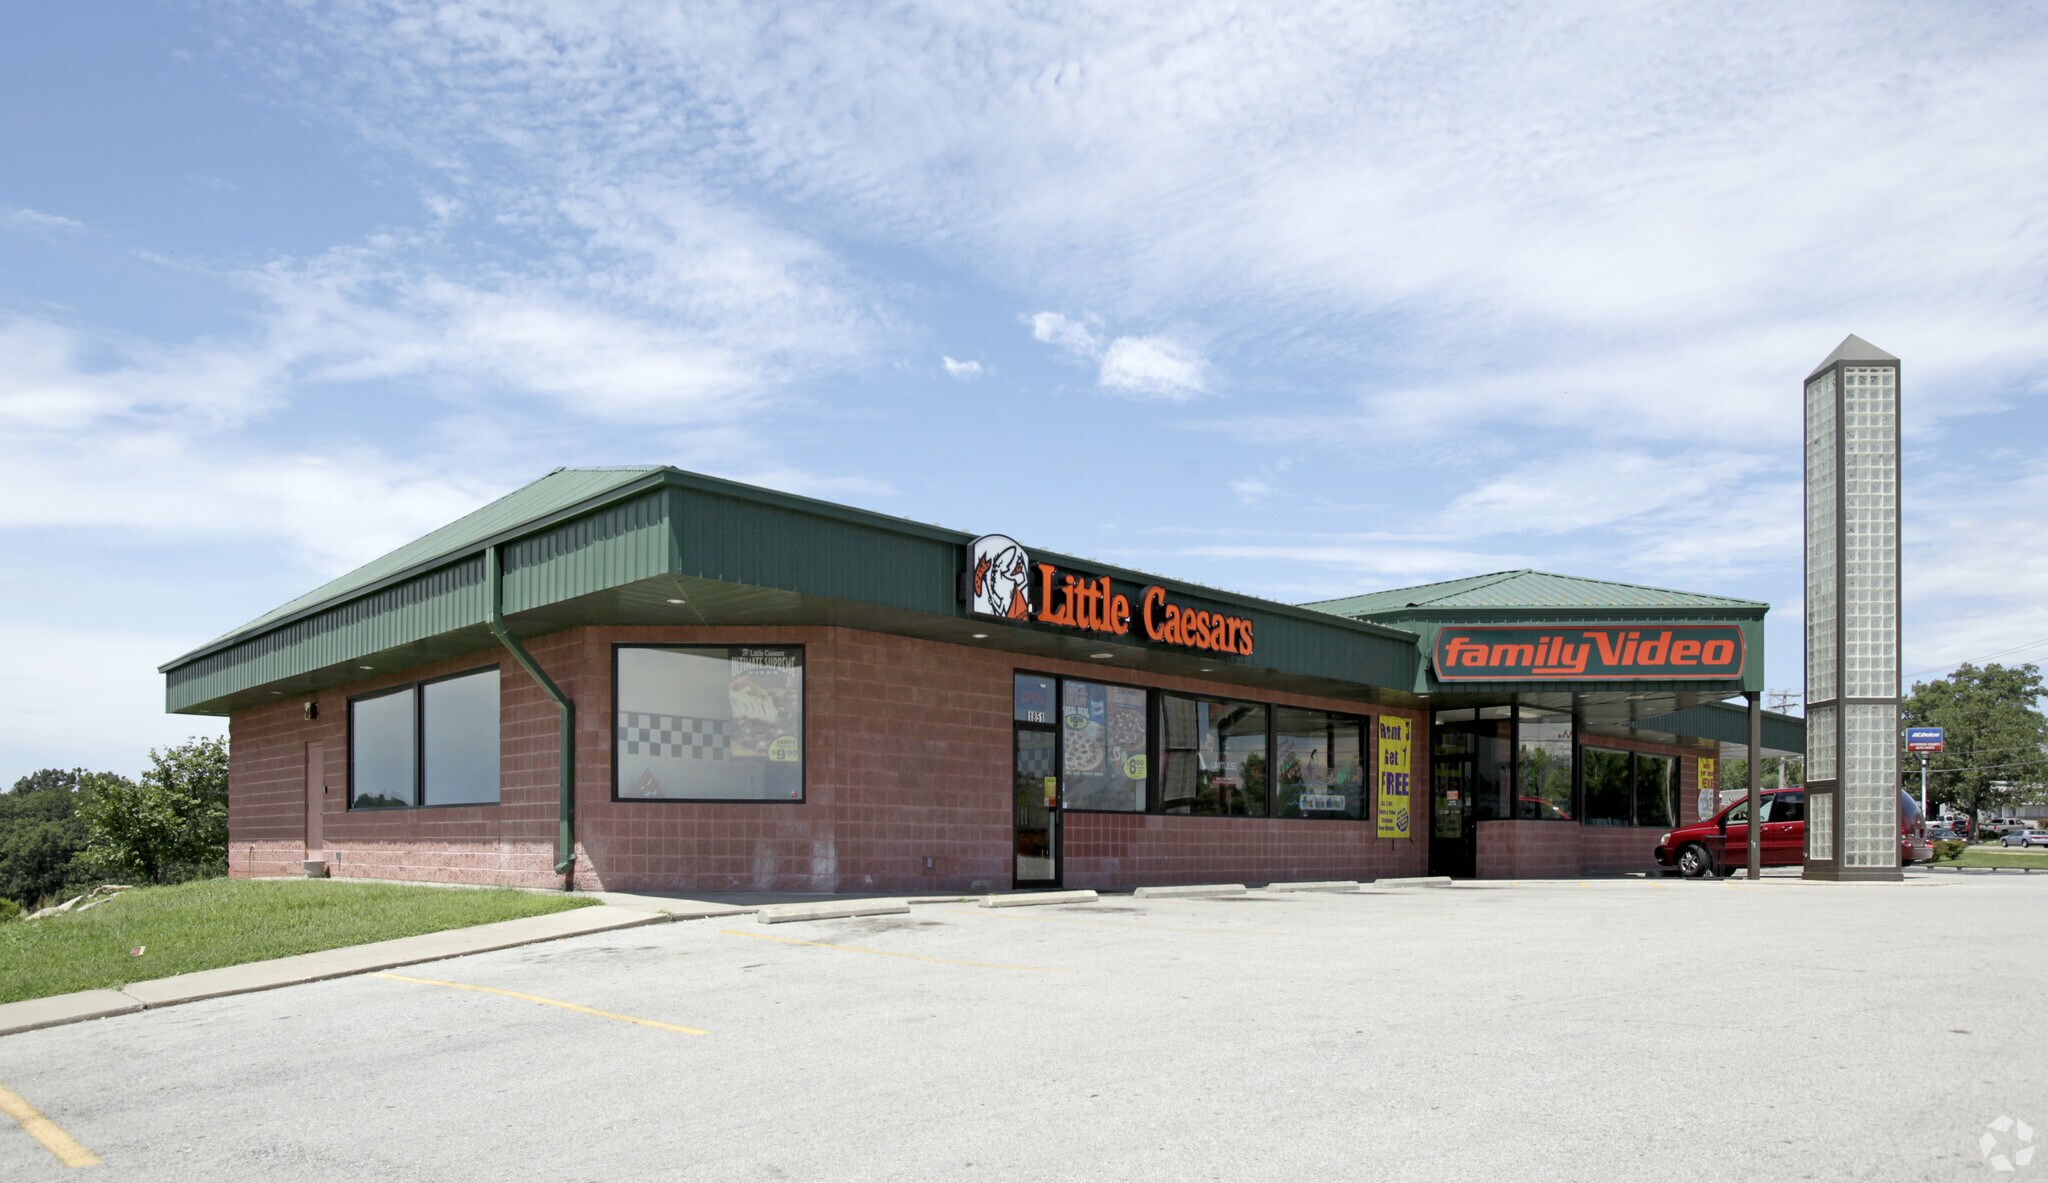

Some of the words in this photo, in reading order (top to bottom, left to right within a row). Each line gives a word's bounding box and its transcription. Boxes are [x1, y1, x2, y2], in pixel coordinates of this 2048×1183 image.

[1037, 562, 1130, 636] Little
[1142, 584, 1254, 656] Caesars
[1444, 635, 1591, 674] family
[1582, 631, 1735, 666] Video
[731, 657, 762, 676] ULTIMATE
[763, 656, 796, 678] SUPREME
[1380, 723, 1402, 741] Rent
[1405, 721, 1410, 742] 3
[1385, 748, 1399, 766] Get
[1401, 746, 1408, 767] 1
[1381, 771, 1410, 797] FREE
